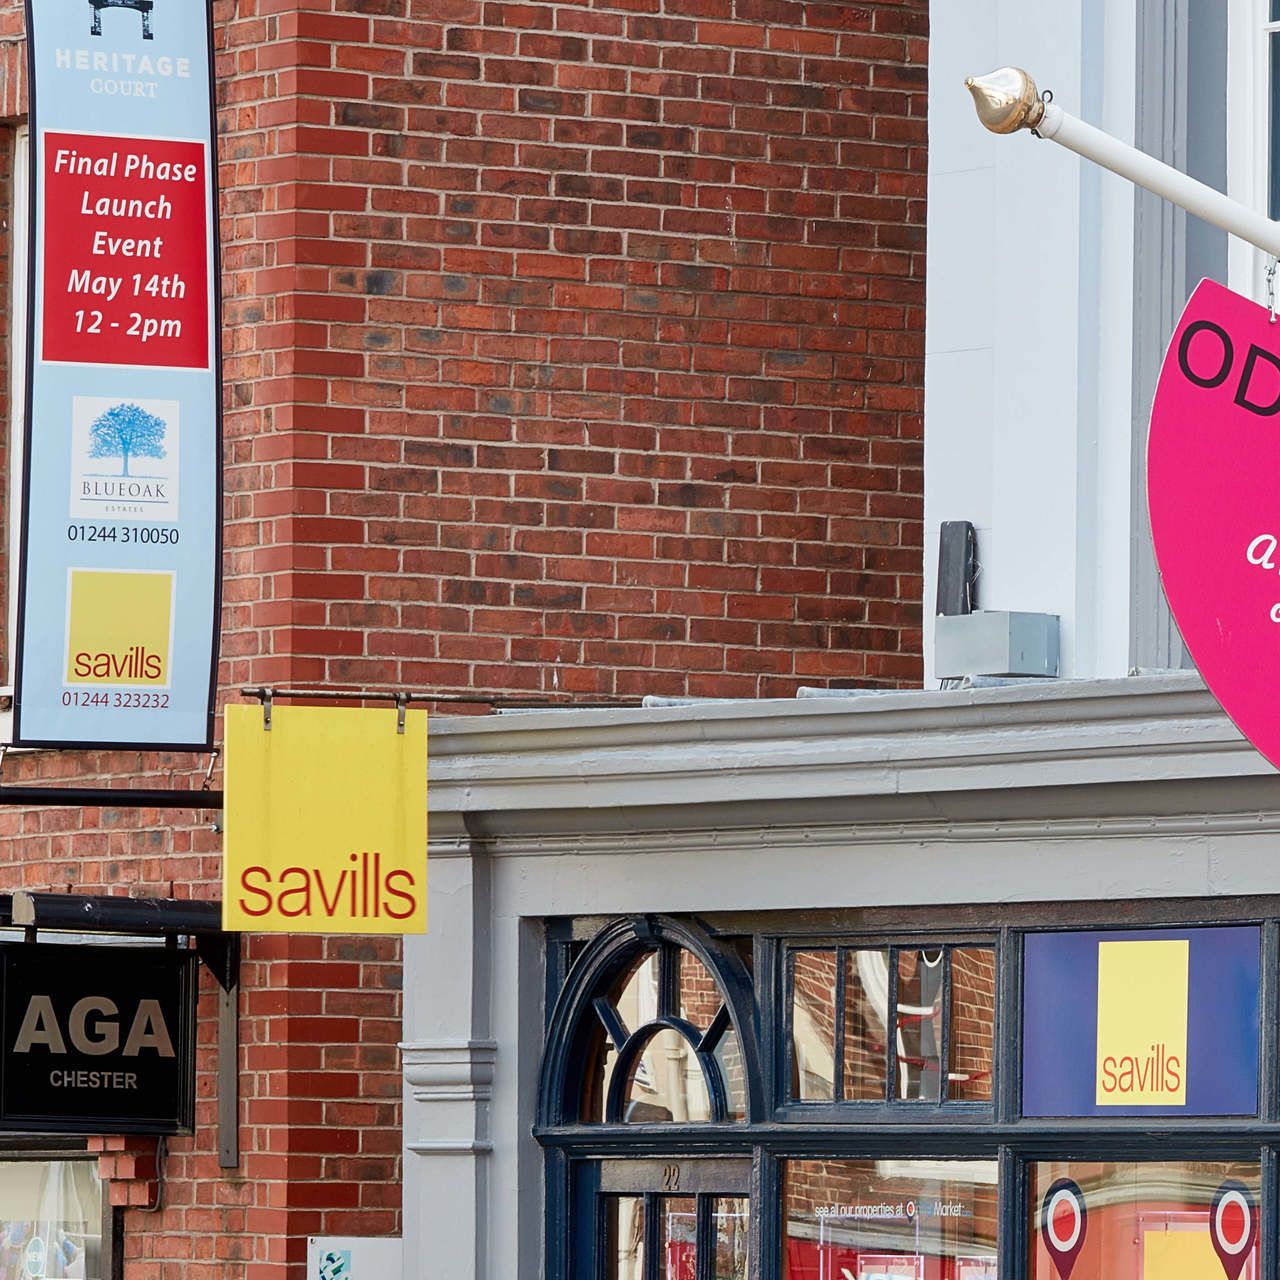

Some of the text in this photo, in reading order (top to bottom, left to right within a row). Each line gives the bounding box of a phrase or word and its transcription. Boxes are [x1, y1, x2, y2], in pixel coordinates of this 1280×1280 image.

[55, 48, 192, 78] HERITAGE
[90, 78, 158, 98] COURT
[54, 149, 197, 182] Final Phase
[81, 191, 172, 220] Launch
[92, 231, 163, 258] Event
[68, 269, 186, 301] May 14th
[74, 310, 101, 333] 12
[126, 312, 181, 342] 2pm
[82, 480, 166, 498] BLUEOAK
[105, 505, 144, 513] ESTATES
[67, 525, 179, 544] 01244 310050
[1246, 534, 1278, 569] A
[74, 646, 162, 679] savills
[61, 691, 170, 709] 01244 323232
[239, 852, 417, 919] savills
[13, 995, 175, 1058] AGA
[49, 1070, 137, 1090] CHESTER
[1102, 1043, 1181, 1094] savills
[663, 1163, 680, 1191] 22
[814, 1205, 829, 1217] see
[829, 1203, 839, 1216] all
[840, 1205, 855, 1217] our
[855, 1202, 894, 1220] properties
[895, 1203, 904, 1216] at
